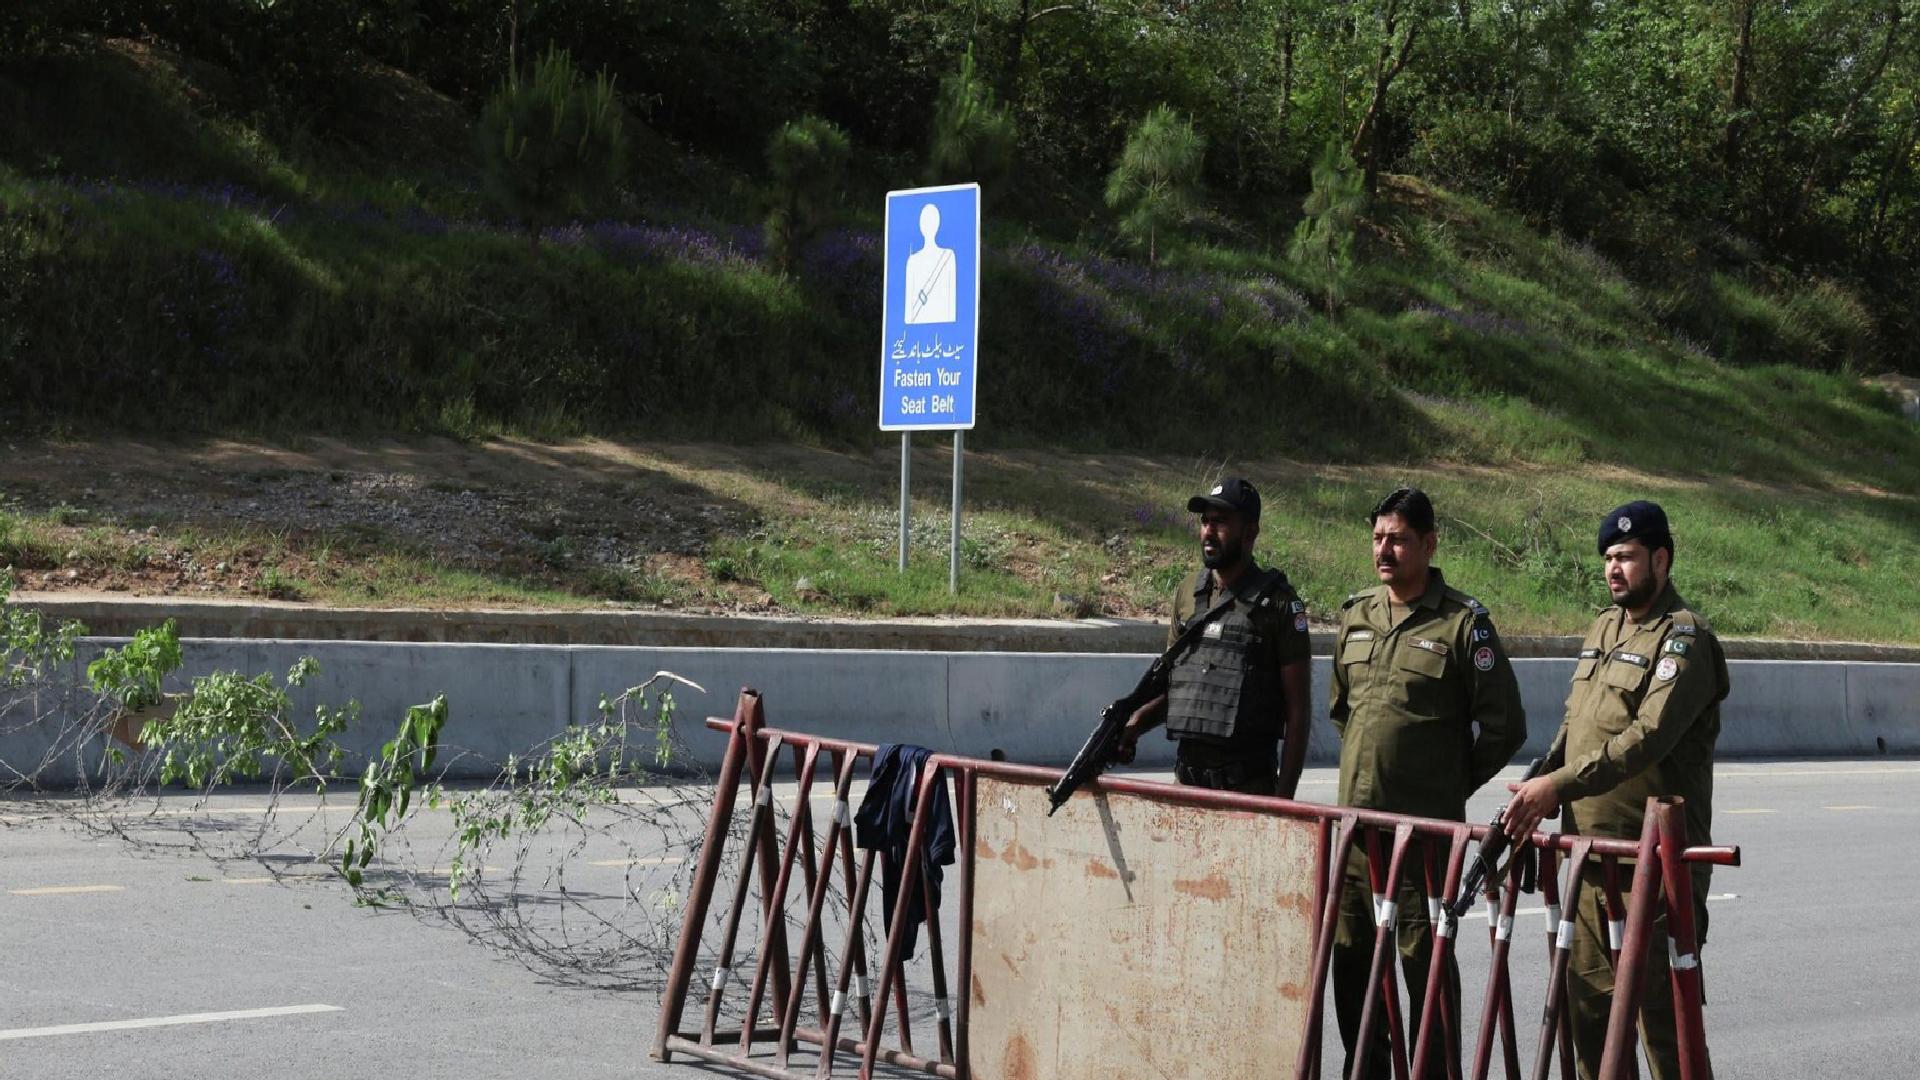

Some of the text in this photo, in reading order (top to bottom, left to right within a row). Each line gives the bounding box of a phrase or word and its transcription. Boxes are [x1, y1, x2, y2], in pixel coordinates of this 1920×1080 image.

[894, 368, 961, 387] Fasten Your
[901, 394, 954, 414] Seat Belt
